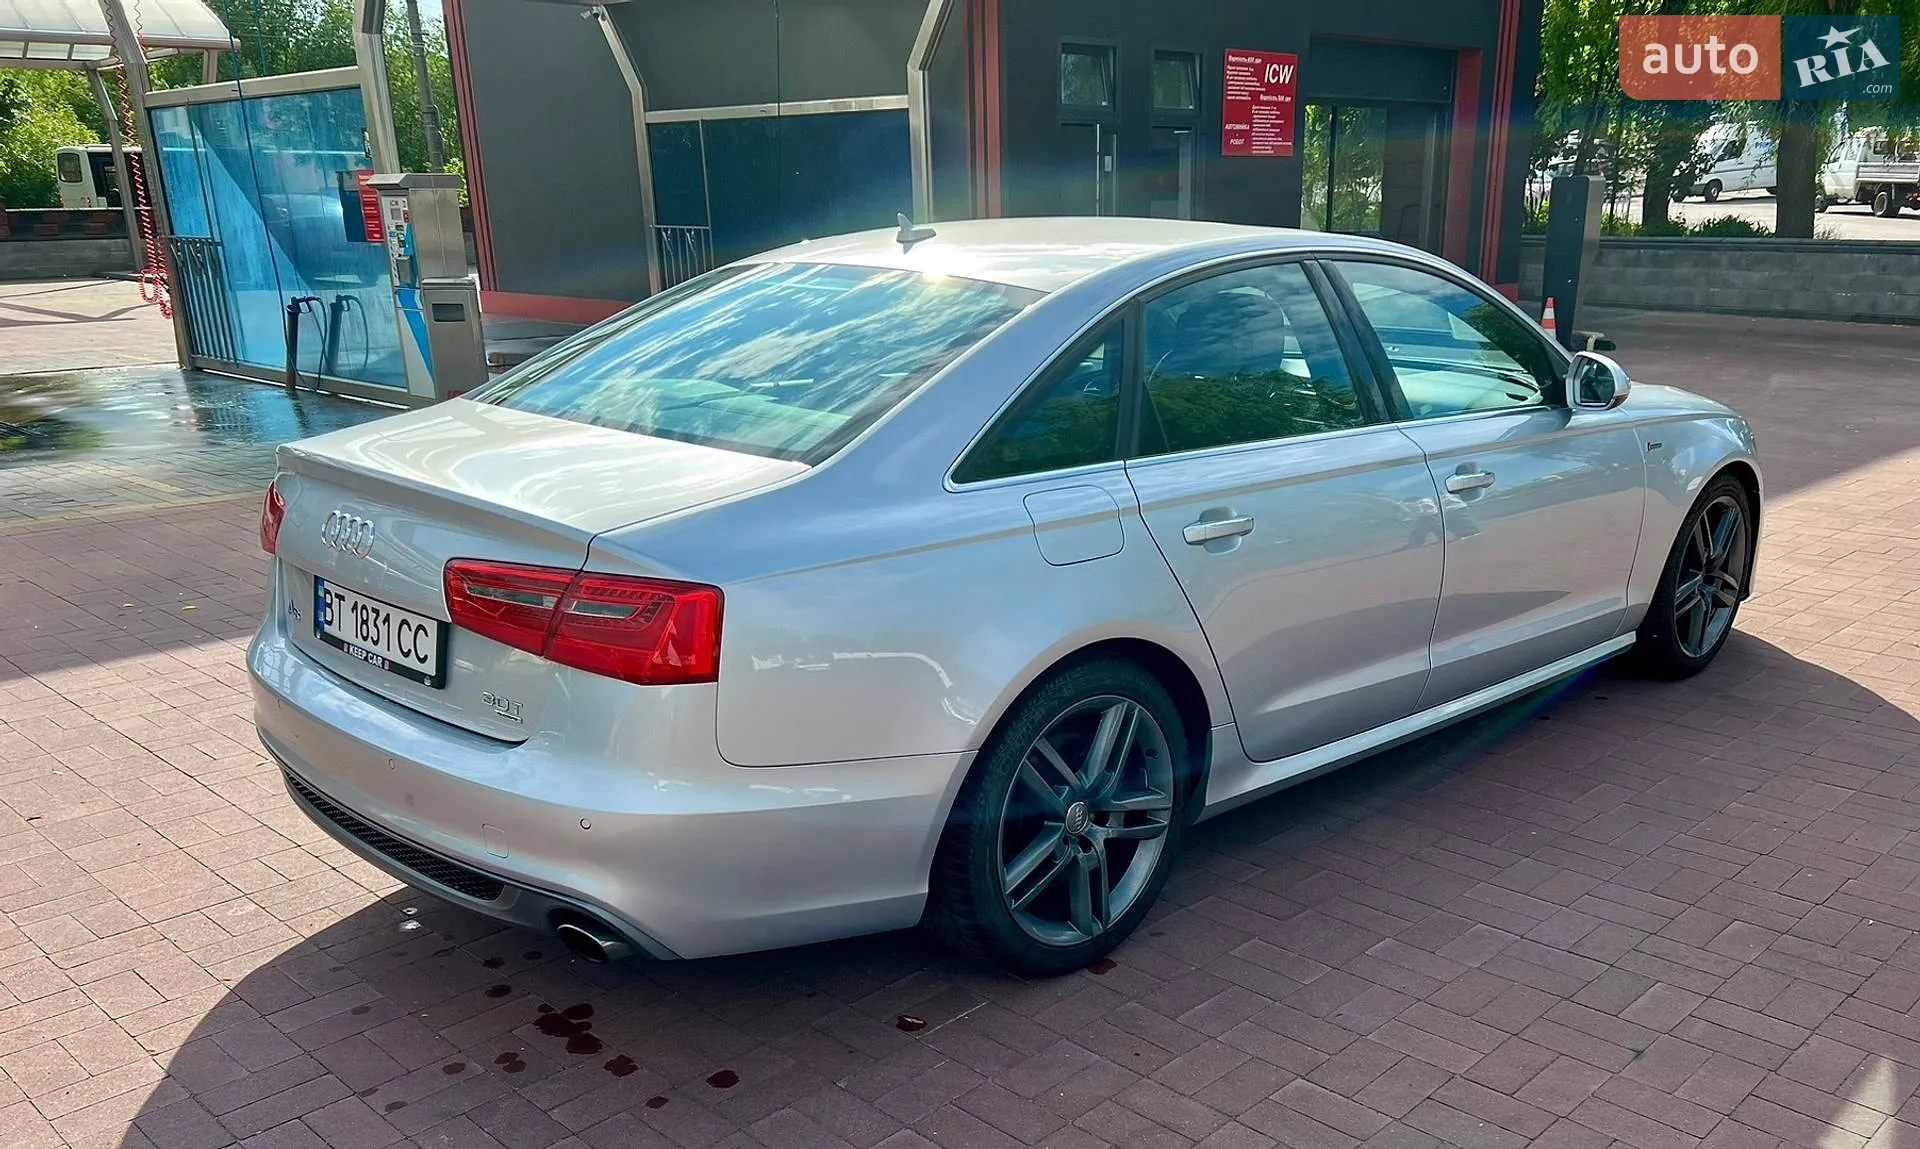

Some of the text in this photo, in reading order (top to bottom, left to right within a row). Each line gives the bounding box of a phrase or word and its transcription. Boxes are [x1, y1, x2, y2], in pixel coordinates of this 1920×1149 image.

[1264, 64, 1294, 84] ICW
[324, 588, 429, 664] BT 1831 CC
[349, 645, 383, 668] KEEP CAR
